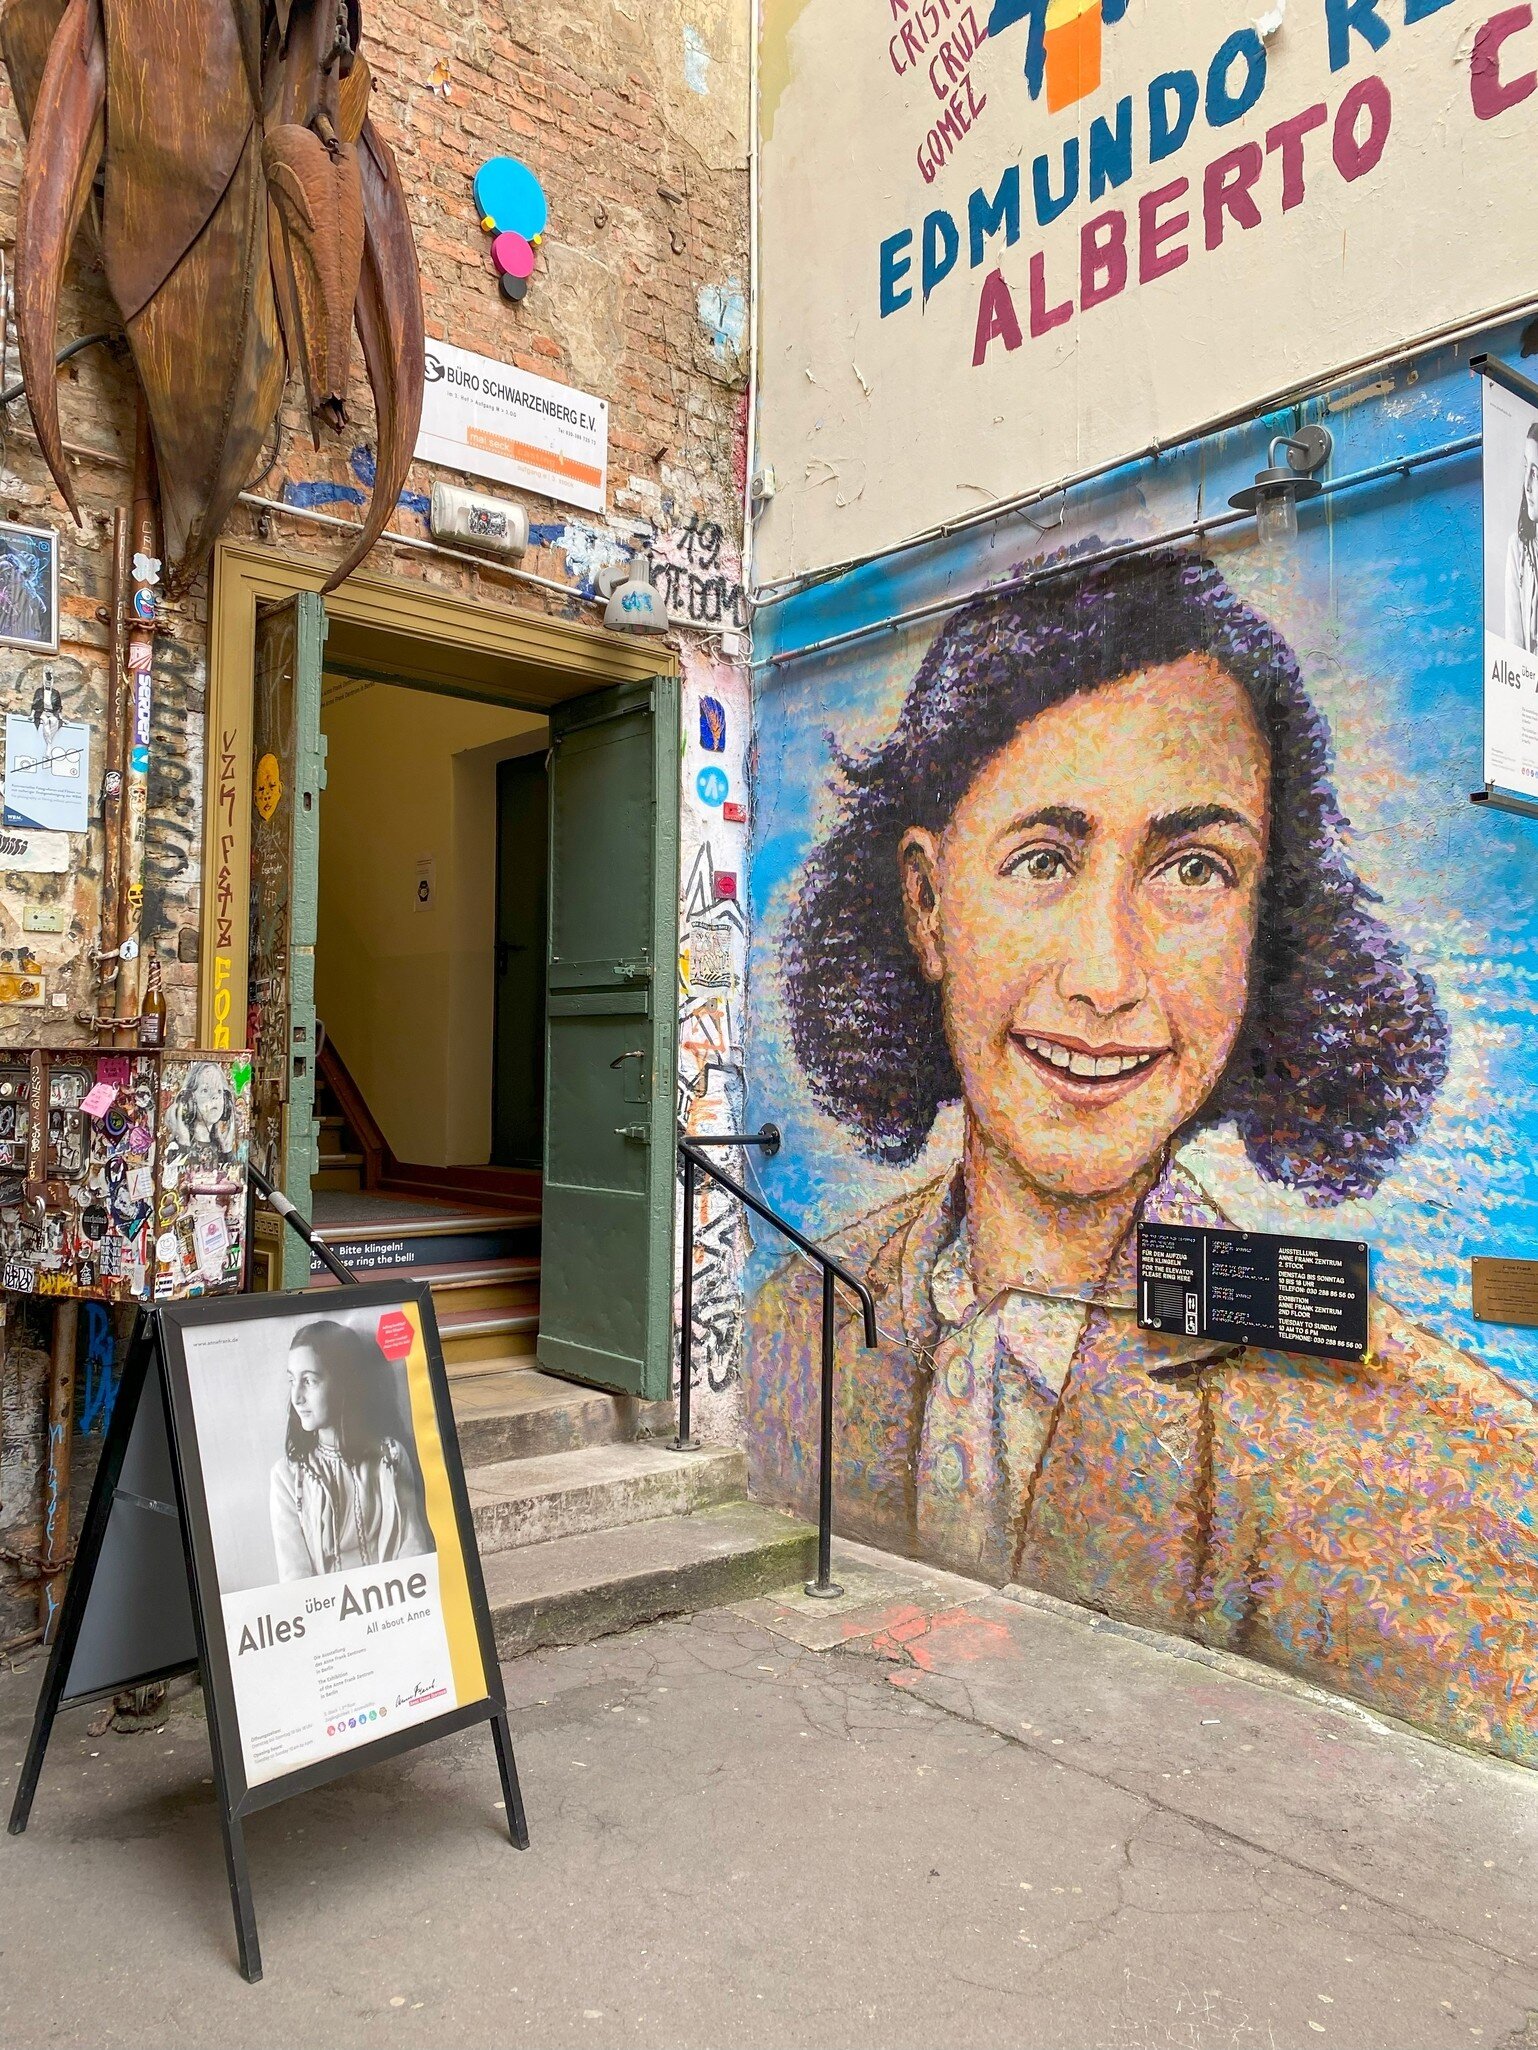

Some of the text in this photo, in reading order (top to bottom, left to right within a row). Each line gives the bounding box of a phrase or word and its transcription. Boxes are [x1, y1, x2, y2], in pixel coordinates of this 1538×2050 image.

[929, 6, 988, 100] CRUZ
[917, 71, 987, 184] GOMEZ
[880, 27, 1267, 318] EDMUNDO
[972, 75, 1392, 366] ALBERTO
[447, 366, 597, 432] BÜRO SCHWARZENBERG E.V.
[1491, 660, 1521, 689] Alles
[339, 1244, 362, 1255] Bitte
[364, 1241, 404, 1255] klingeln!
[1278, 1248, 1318, 1257] AUSSTELLUNG
[356, 1257, 375, 1267] ring
[377, 1254, 393, 1264] the
[395, 1252, 415, 1263] bell!
[1155, 1258, 1181, 1266] KLINGELN
[1166, 1252, 1187, 1260] AUFZUG
[1295, 1256, 1314, 1264] FRANK
[1315, 1259, 1342, 1267] ZENTRUM
[1166, 1267, 1194, 1276] ELEVATOR
[1285, 1262, 1304, 1270] STOCK
[1142, 1271, 1161, 1279] PLEASE
[1278, 1271, 1306, 1280] DIENSTAG
[1317, 1275, 1345, 1284] SONNTAG
[1279, 1285, 1305, 1293] TELEFON:
[1278, 1295, 1309, 1304] EXHIBITION
[1291, 1310, 1311, 1318] FLOOR
[1295, 1304, 1314, 1312] FRANK
[1315, 1307, 1342, 1315] ZENTRUM
[1278, 1318, 1304, 1327] TUESDAY
[1314, 1323, 1337, 1332] SUNDAY
[1279, 1332, 1313, 1343] TELEPHONE:
[238, 1573, 427, 1656] Alles über Anne
[366, 1608, 431, 1635] All about Anne
